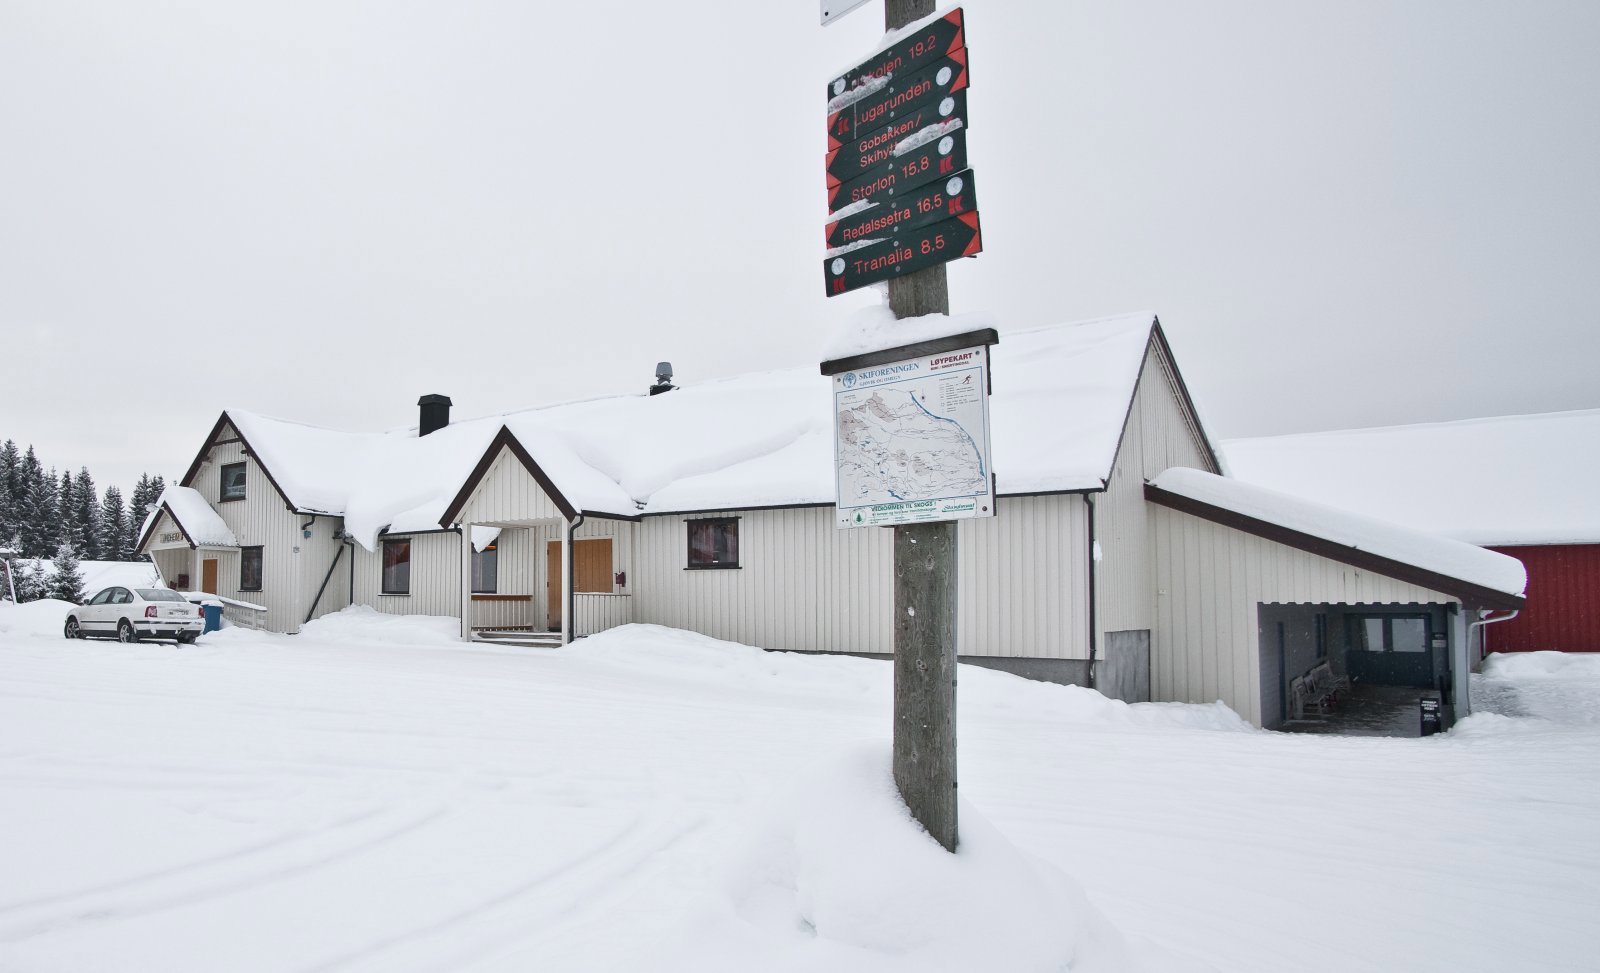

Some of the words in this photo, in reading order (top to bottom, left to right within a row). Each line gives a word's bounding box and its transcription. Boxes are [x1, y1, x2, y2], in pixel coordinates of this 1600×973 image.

[908, 35, 936, 59] 19.2
[855, 80, 931, 126] Lugarunden
[852, 173, 895, 202] Storlon
[902, 156, 929, 179] 15.8
[843, 208, 911, 242] Redalssetra
[917, 193, 942, 214] 16.5
[854, 248, 913, 275] Tranalia
[921, 235, 945, 254] 8.5
[859, 363, 919, 380] SKIFORENINGEN
[931, 352, 972, 366] LØYPEKART
